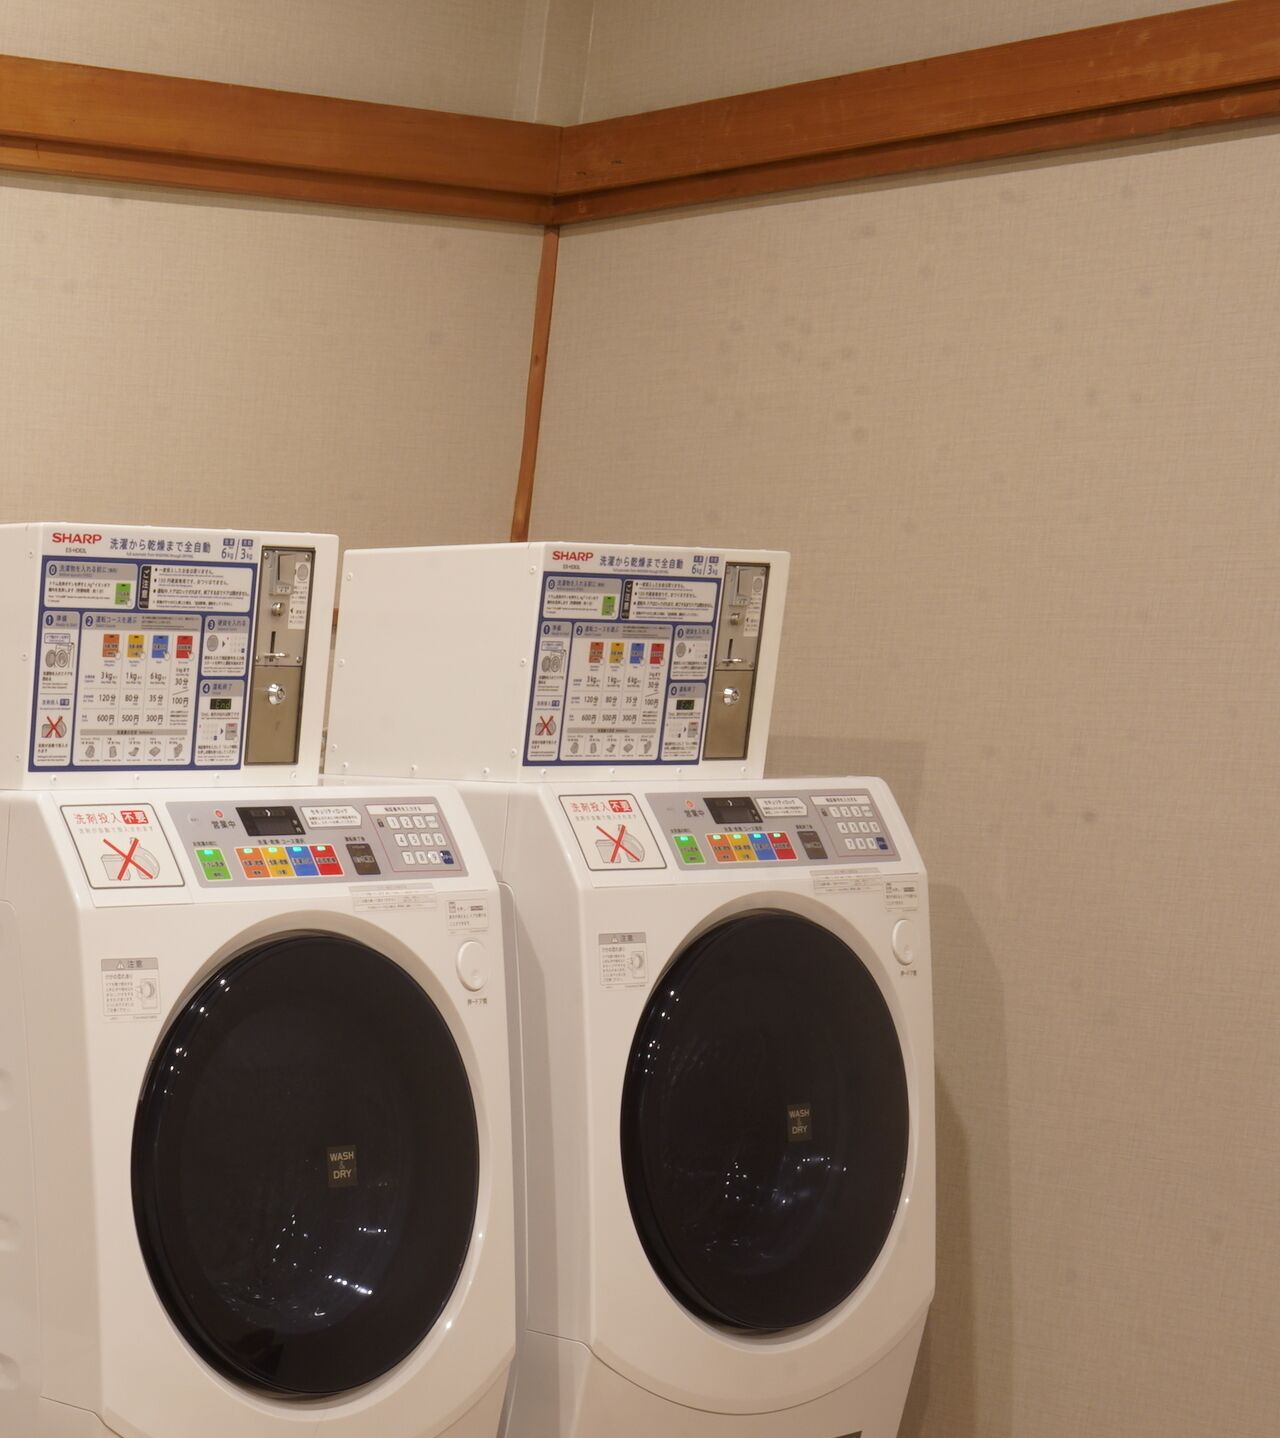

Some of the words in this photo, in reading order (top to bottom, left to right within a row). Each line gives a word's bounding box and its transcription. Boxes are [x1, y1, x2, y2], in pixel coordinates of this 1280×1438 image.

[52, 533, 103, 545] SHARP
[552, 551, 593, 561] SHARP
[330, 1151, 354, 1161] WASH
[333, 1169, 352, 1179] DRY
